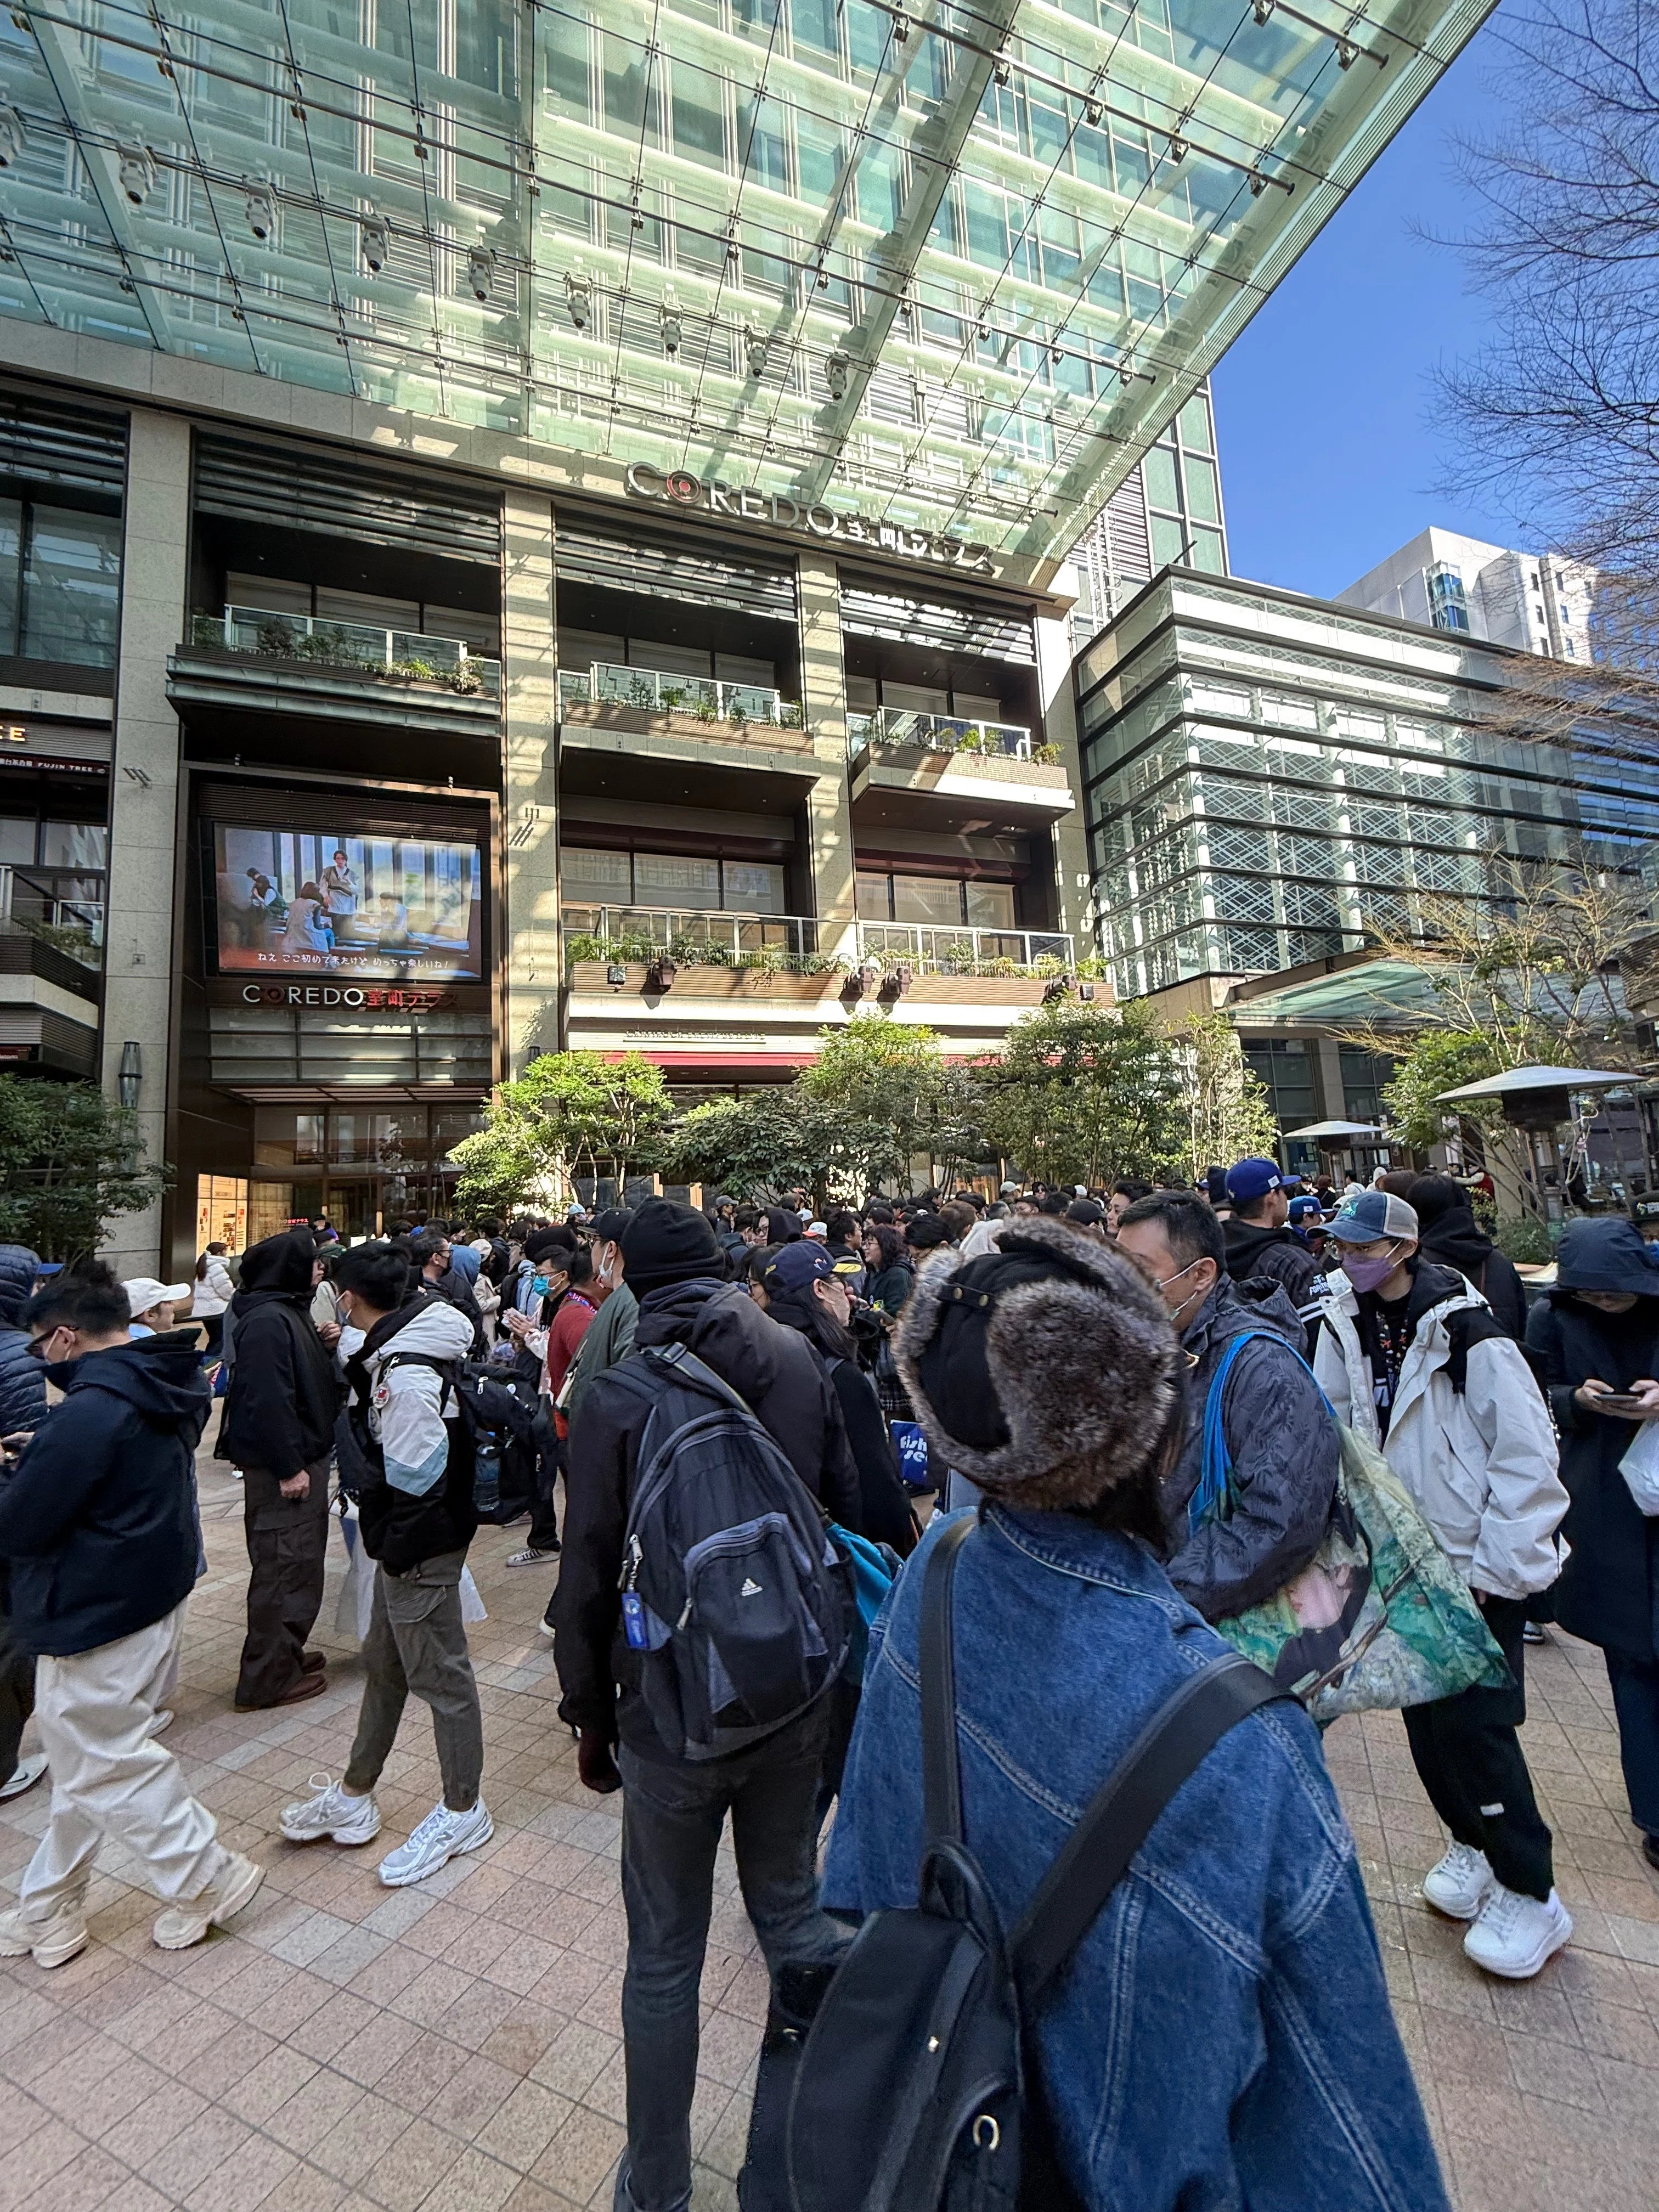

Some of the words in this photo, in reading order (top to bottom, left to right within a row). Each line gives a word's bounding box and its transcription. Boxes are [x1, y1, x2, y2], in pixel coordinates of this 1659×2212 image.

[0, 725, 26, 742] E
[258, 953, 276, 962] ねえ
[900, 1435, 927, 1452] fish
[904, 1450, 928, 1463] se
